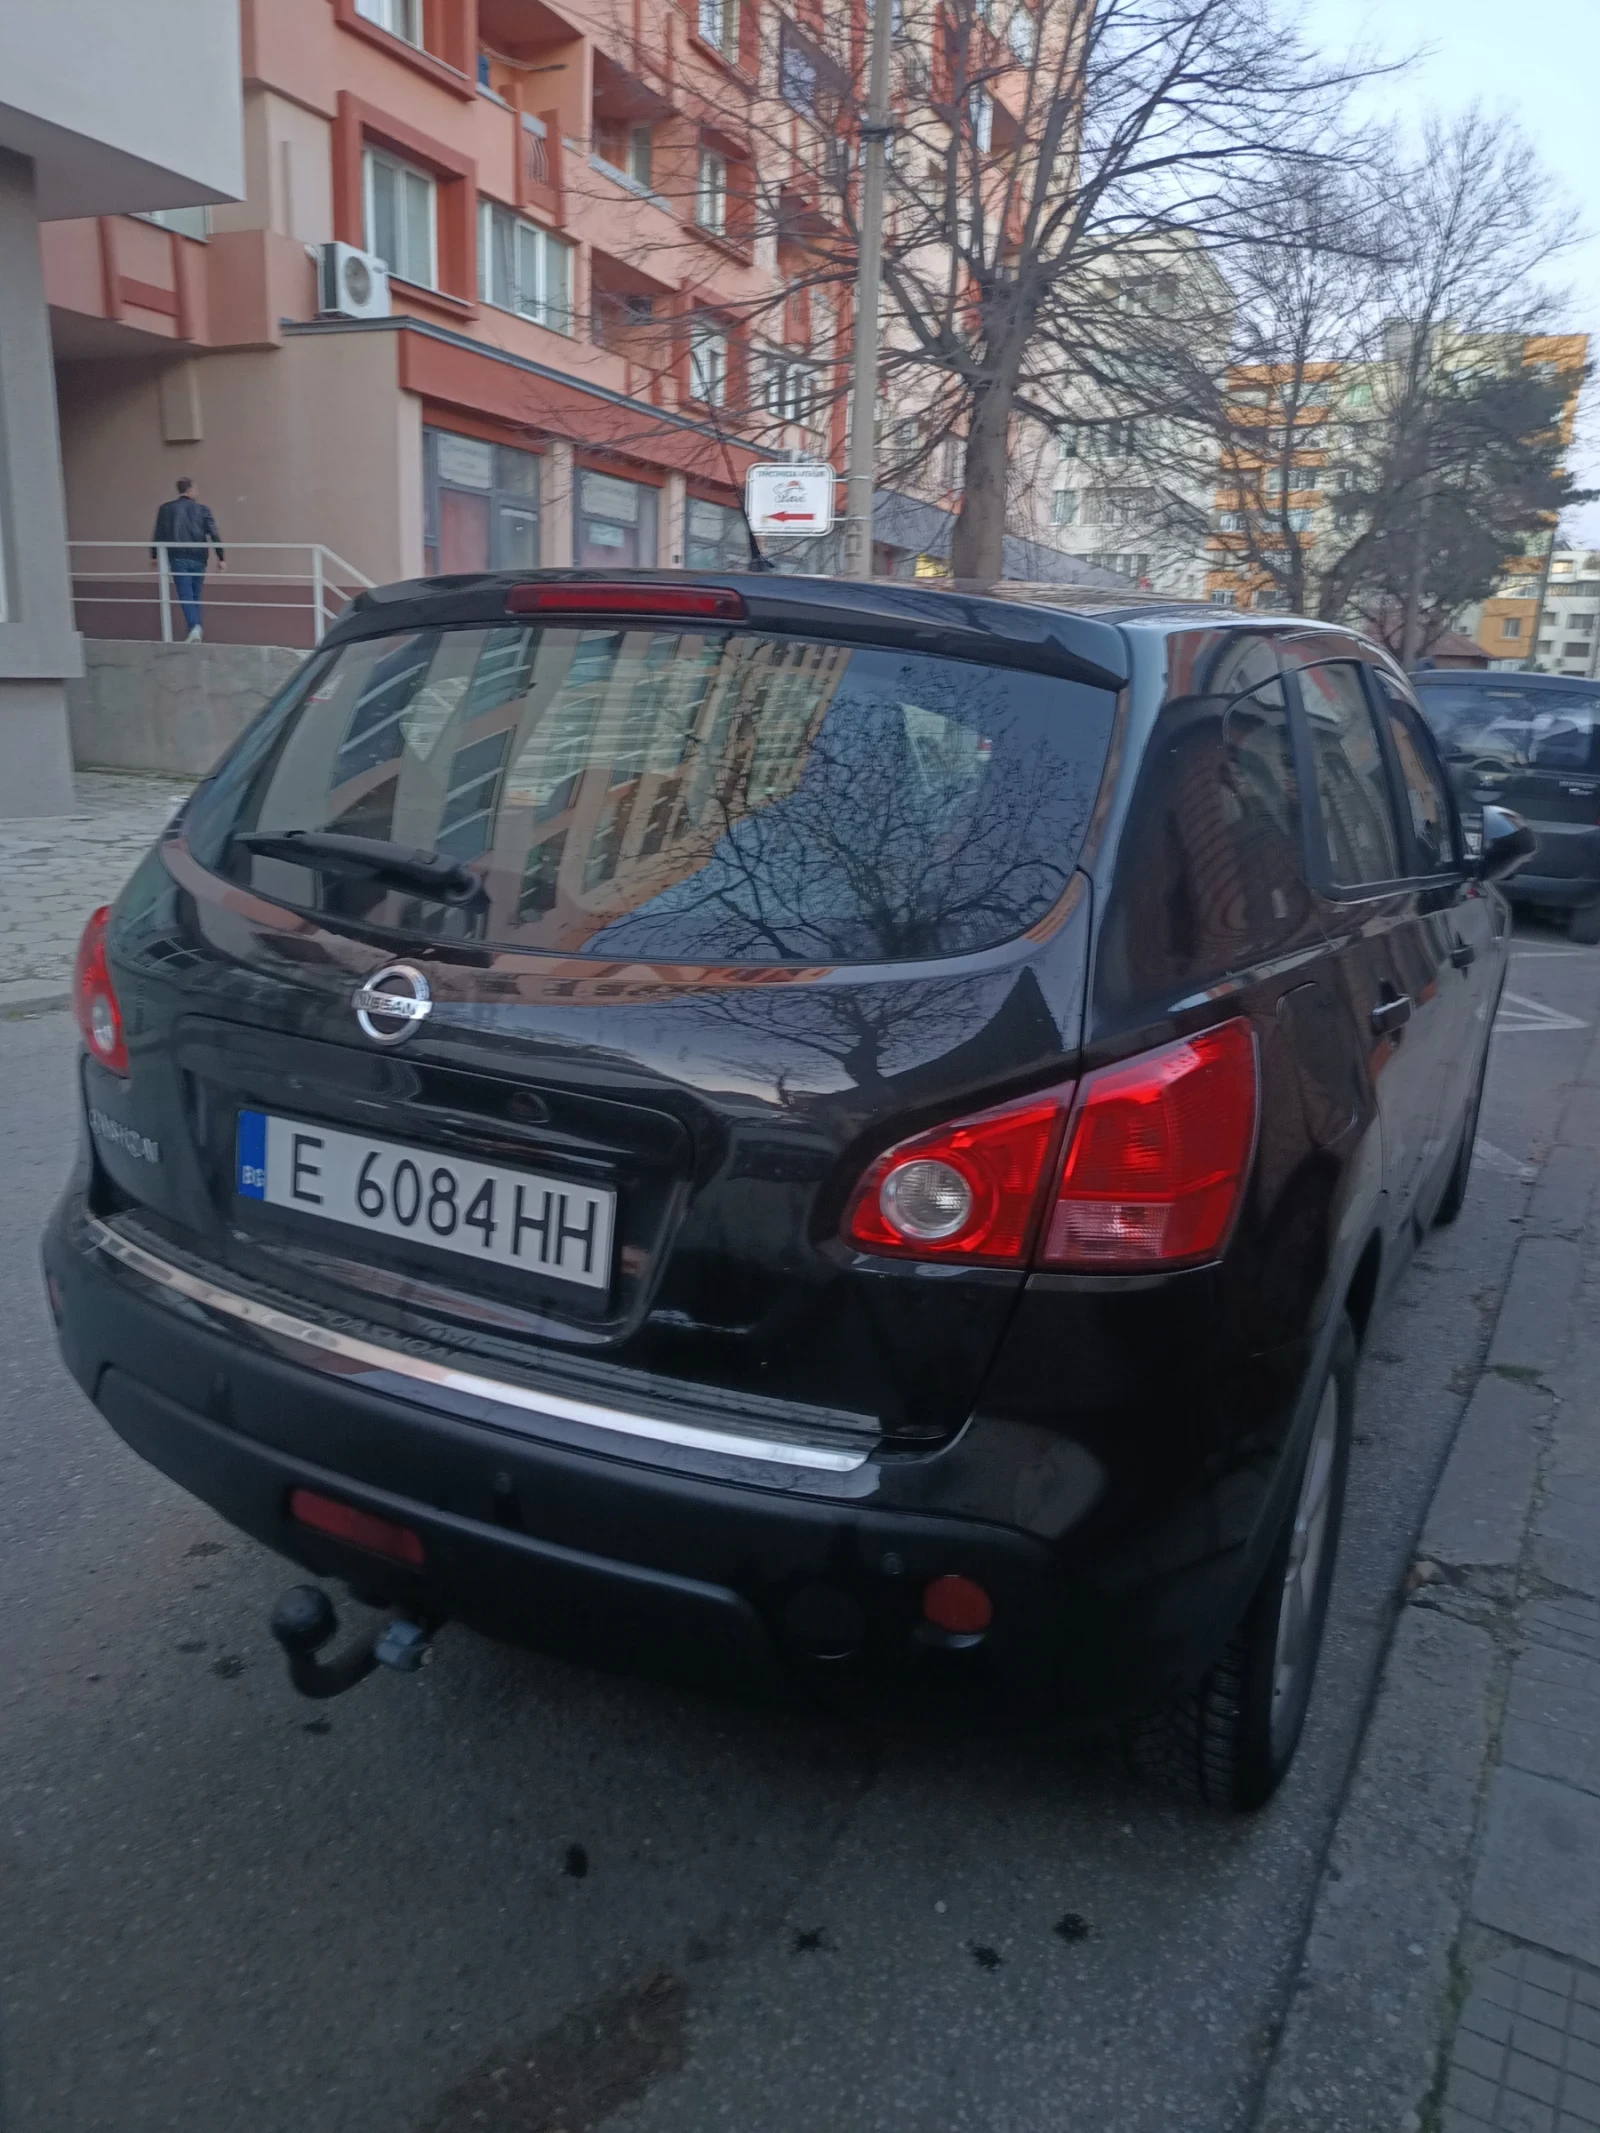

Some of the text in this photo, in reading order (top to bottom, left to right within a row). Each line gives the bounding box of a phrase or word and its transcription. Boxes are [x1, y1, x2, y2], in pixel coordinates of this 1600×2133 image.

[242, 1165, 265, 1187] BG
[292, 1133, 596, 1272] E 6084 HH
